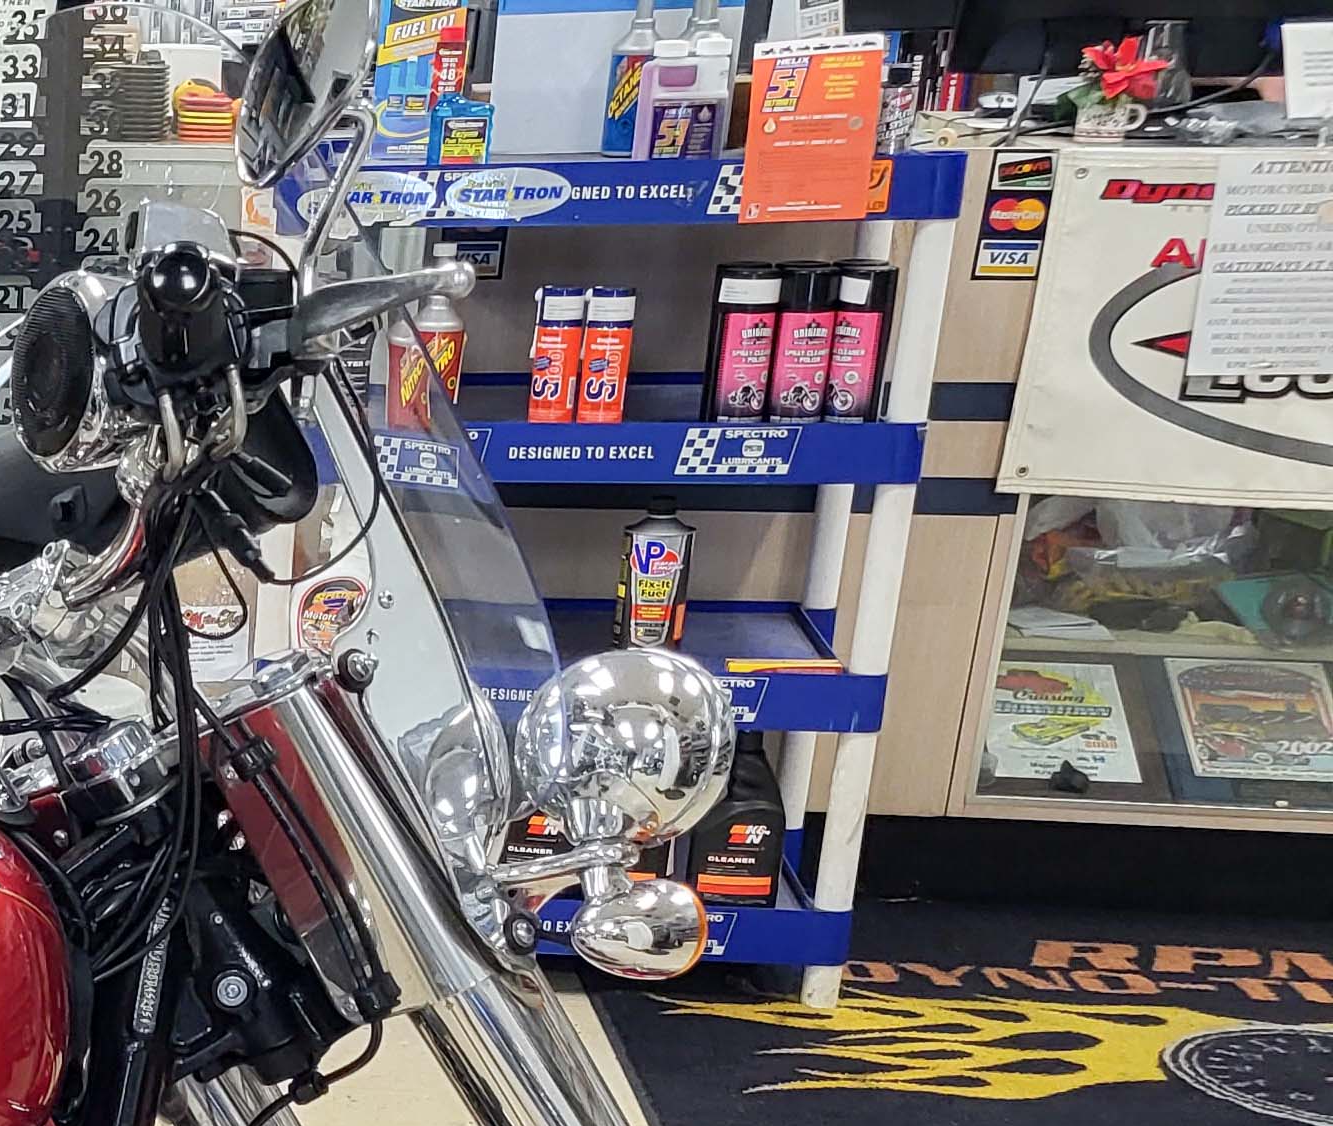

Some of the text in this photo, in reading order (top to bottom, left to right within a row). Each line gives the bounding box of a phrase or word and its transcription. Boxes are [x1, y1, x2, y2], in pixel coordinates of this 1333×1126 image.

[393, 20, 426, 41] FUEL
[3, 55, 39, 81] 33
[776, 57, 811, 67] HELIX
[1, 93, 32, 120] 31
[88, 150, 122, 175] 28
[382, 191, 429, 205] TRON
[460, 185, 563, 202] STAR TRON
[571, 184, 686, 200] GNED TO EXCEL
[85, 189, 122, 214] 26
[989, 209, 1045, 222] MasterCard
[83, 228, 120, 254] 24
[989, 251, 1030, 265] VISA
[399, 358, 426, 409] NITRO
[725, 429, 789, 439] SPECTRO
[404, 441, 451, 455] SPECTRO
[508, 445, 654, 460] DESIGNED TO EXCEL
[721, 457, 783, 465] LUBRICANTS
[404, 466, 452, 480] LUBRICANTS
[634, 540, 666, 575] VP
[638, 579, 671, 589] Fix-It
[640, 589, 667, 598] Fuel
[718, 678, 755, 689] CTRO
[482, 687, 538, 701] DESIGNE
[1276, 740, 1333, 755] 2002
[744, 824, 771, 845] K&N
[507, 845, 553, 855] CLEANER
[706, 855, 756, 865] CLEANER
